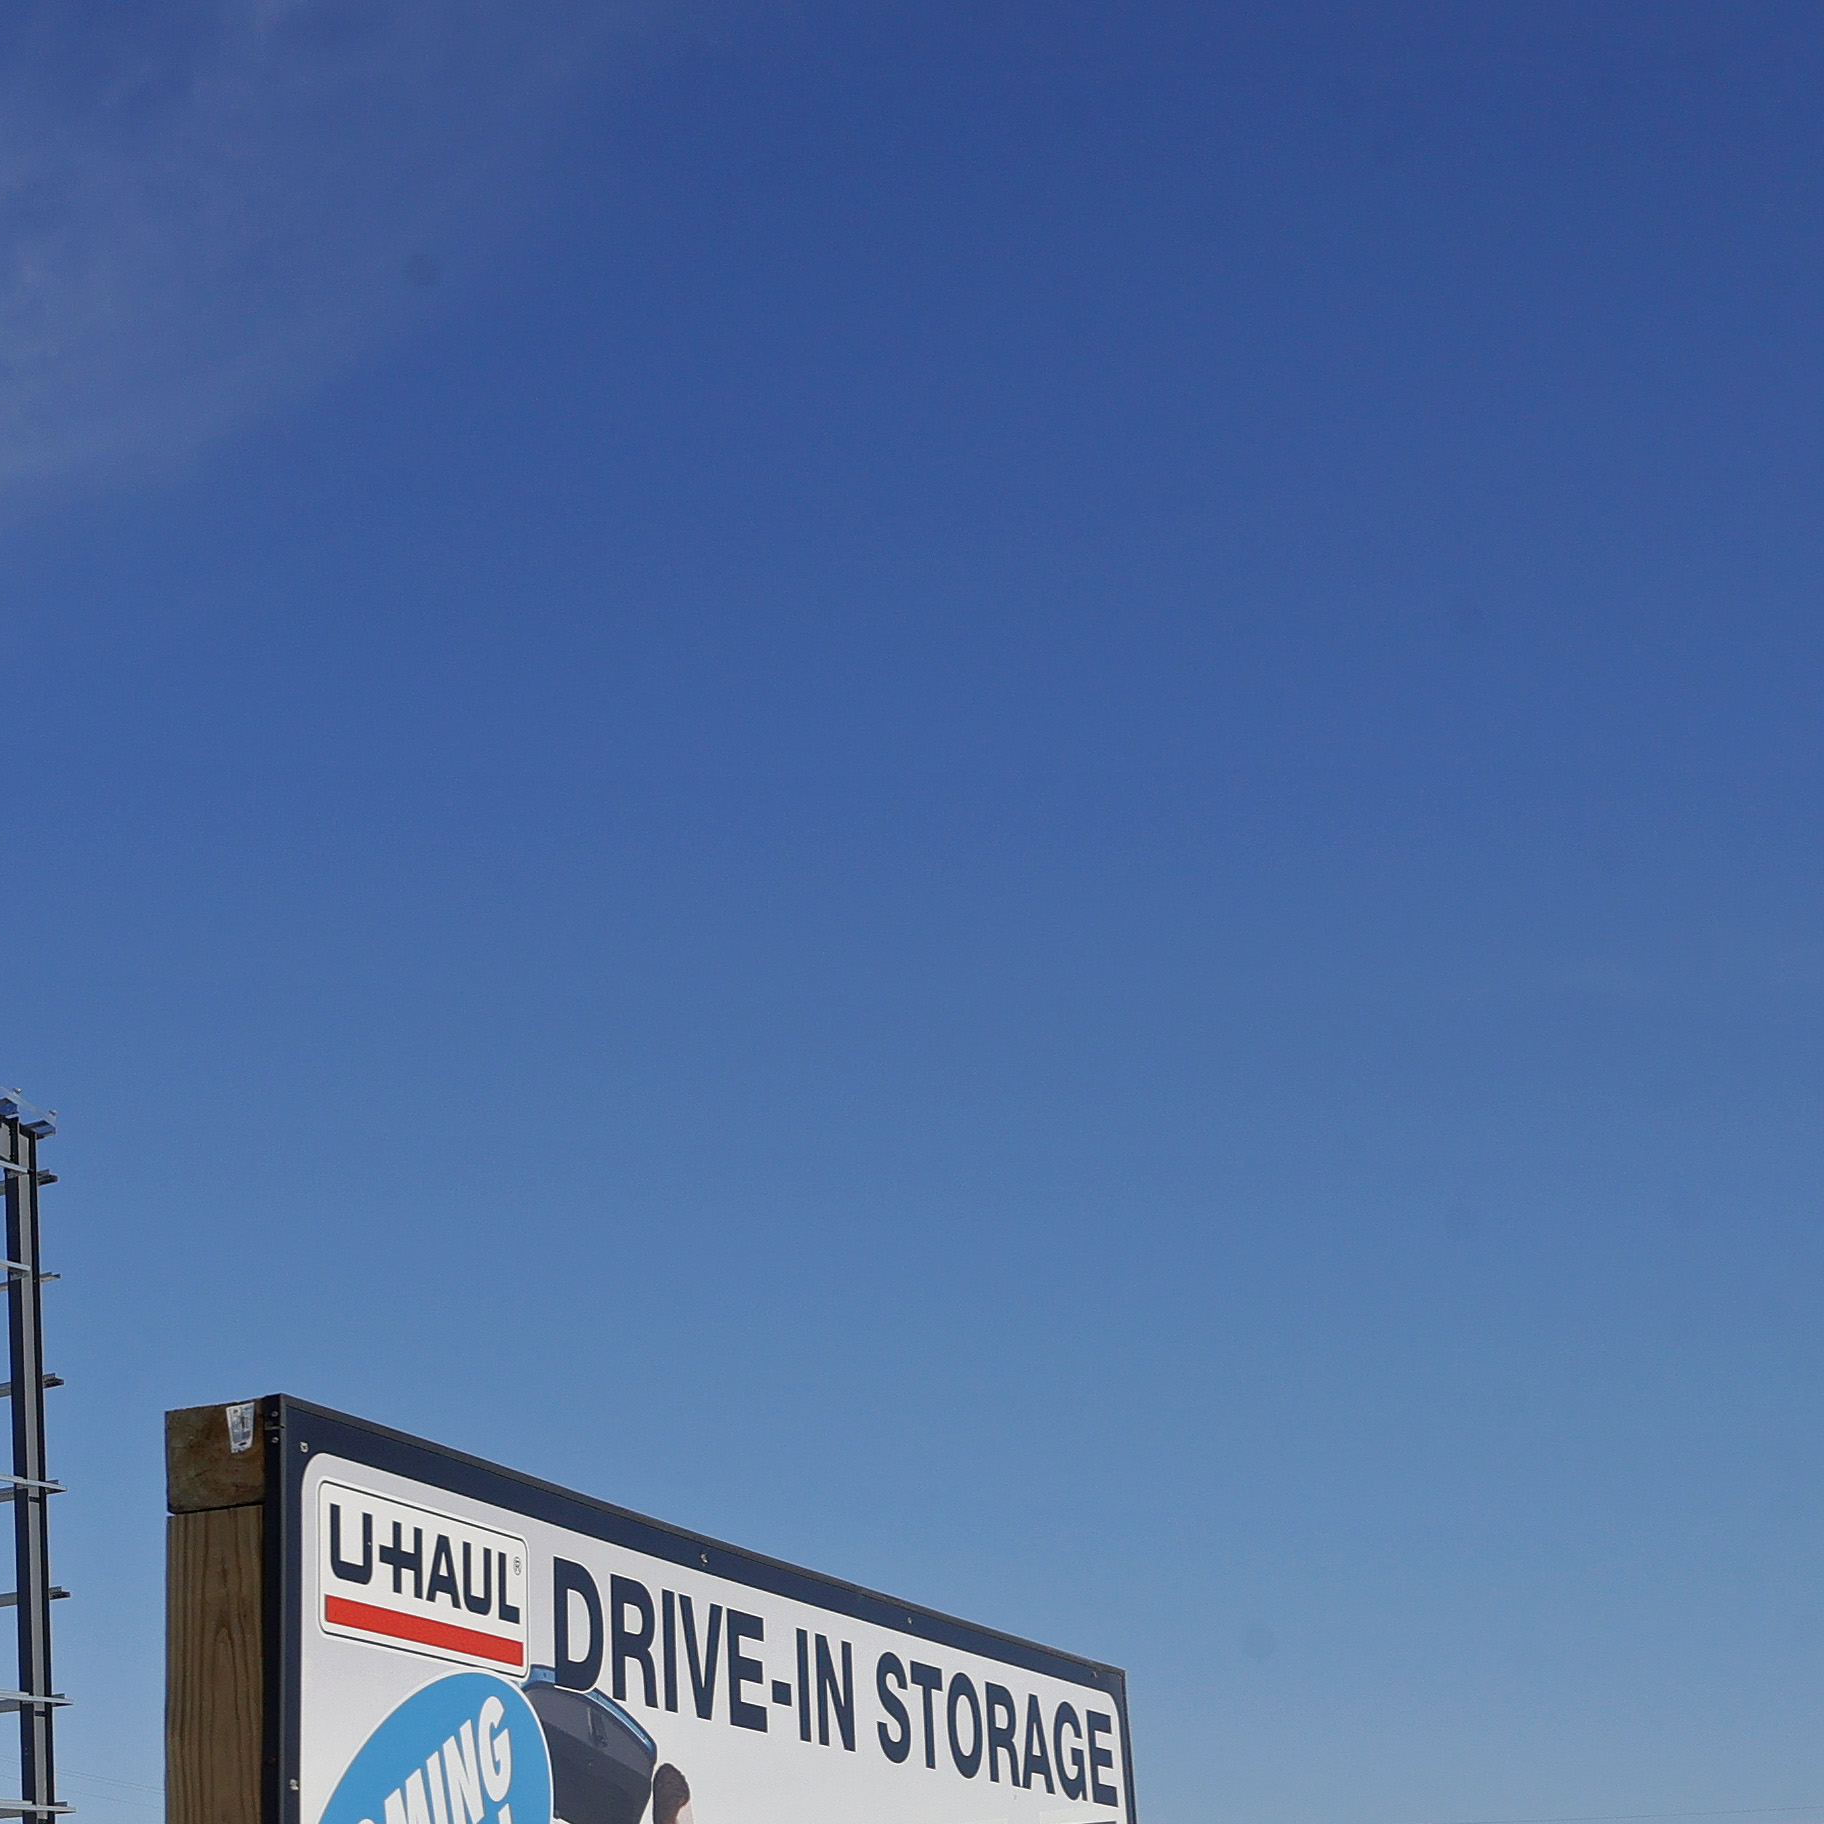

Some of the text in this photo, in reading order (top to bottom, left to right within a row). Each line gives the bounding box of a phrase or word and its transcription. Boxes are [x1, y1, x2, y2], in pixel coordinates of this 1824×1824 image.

[330, 1503, 520, 1625] U-HAUL
[552, 1556, 1119, 1807] DRIVE-IN STORAGE
